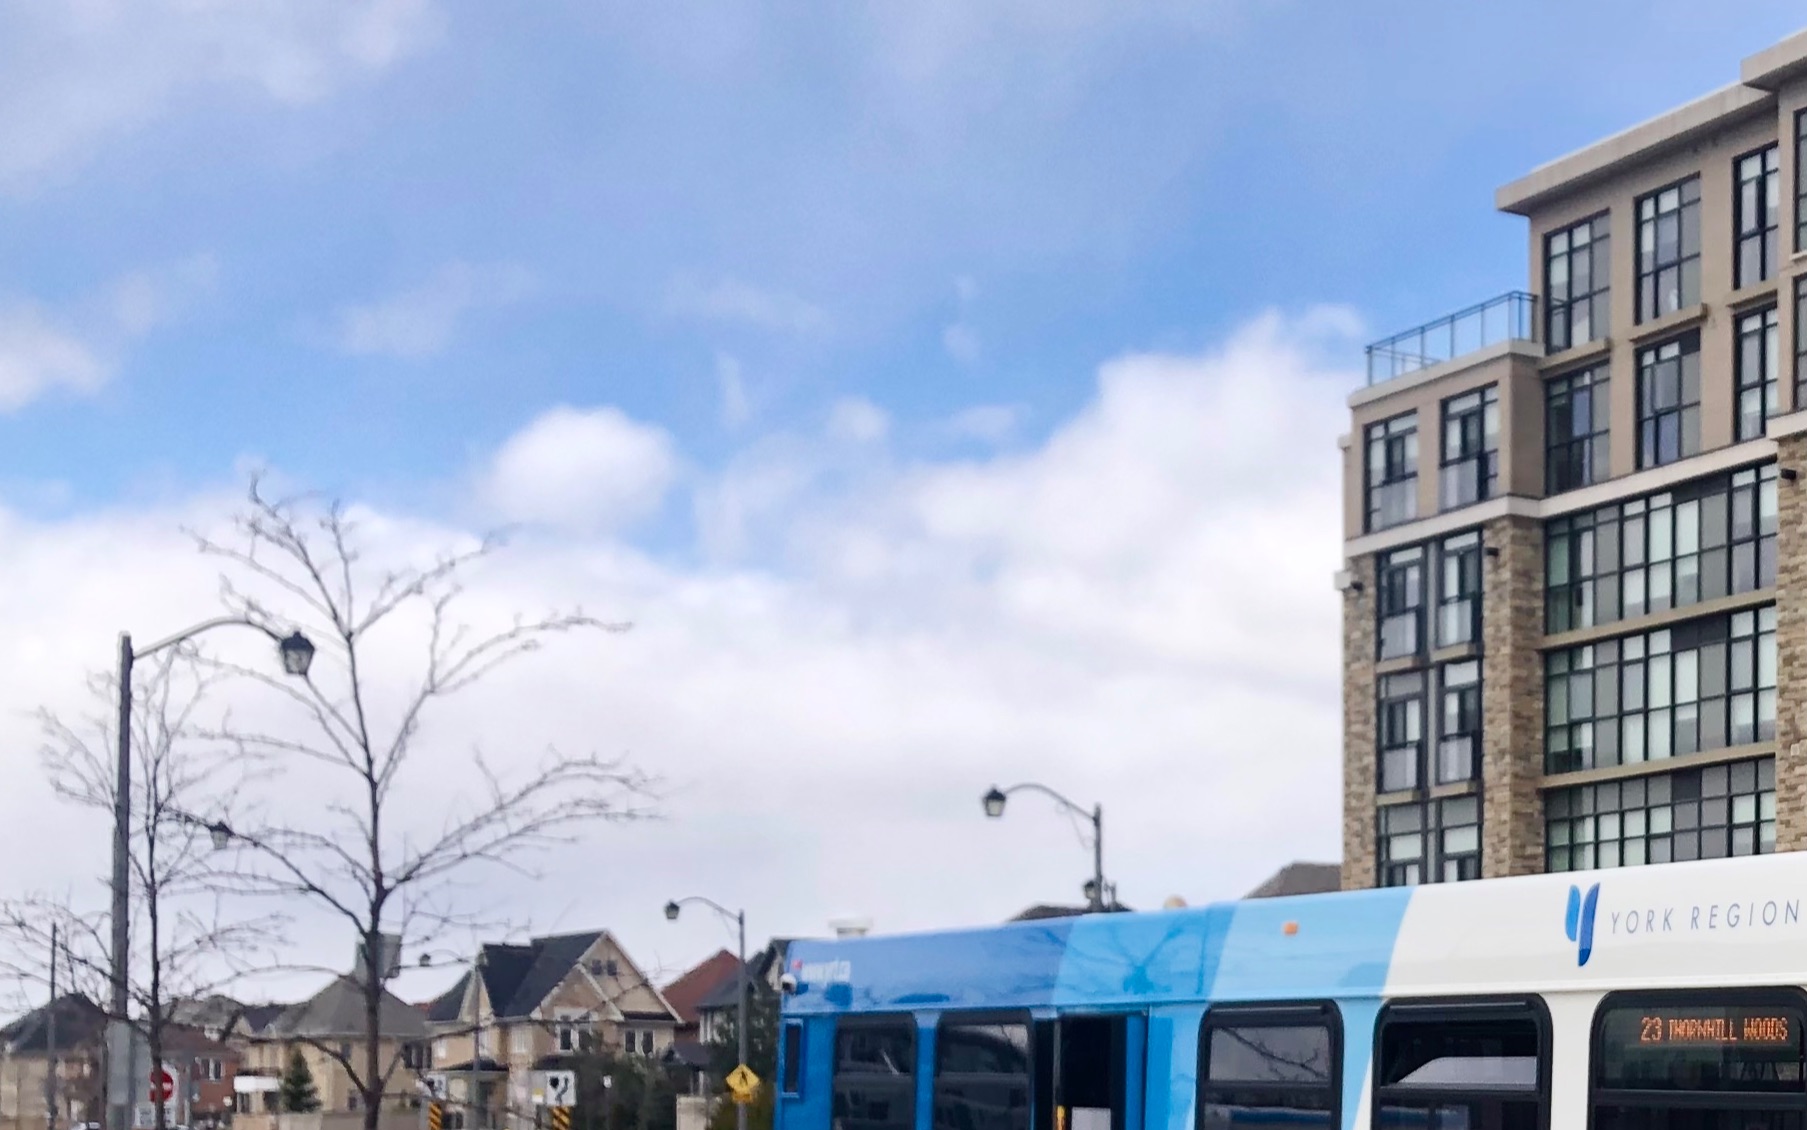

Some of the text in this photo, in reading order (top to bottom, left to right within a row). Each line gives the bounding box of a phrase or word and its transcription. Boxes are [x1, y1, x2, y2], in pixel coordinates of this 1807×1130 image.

[1611, 908, 1674, 934] YORK
[1691, 899, 1800, 930] REGION
[1640, 1016, 1789, 1041] 23 THORNHILL WOODS
